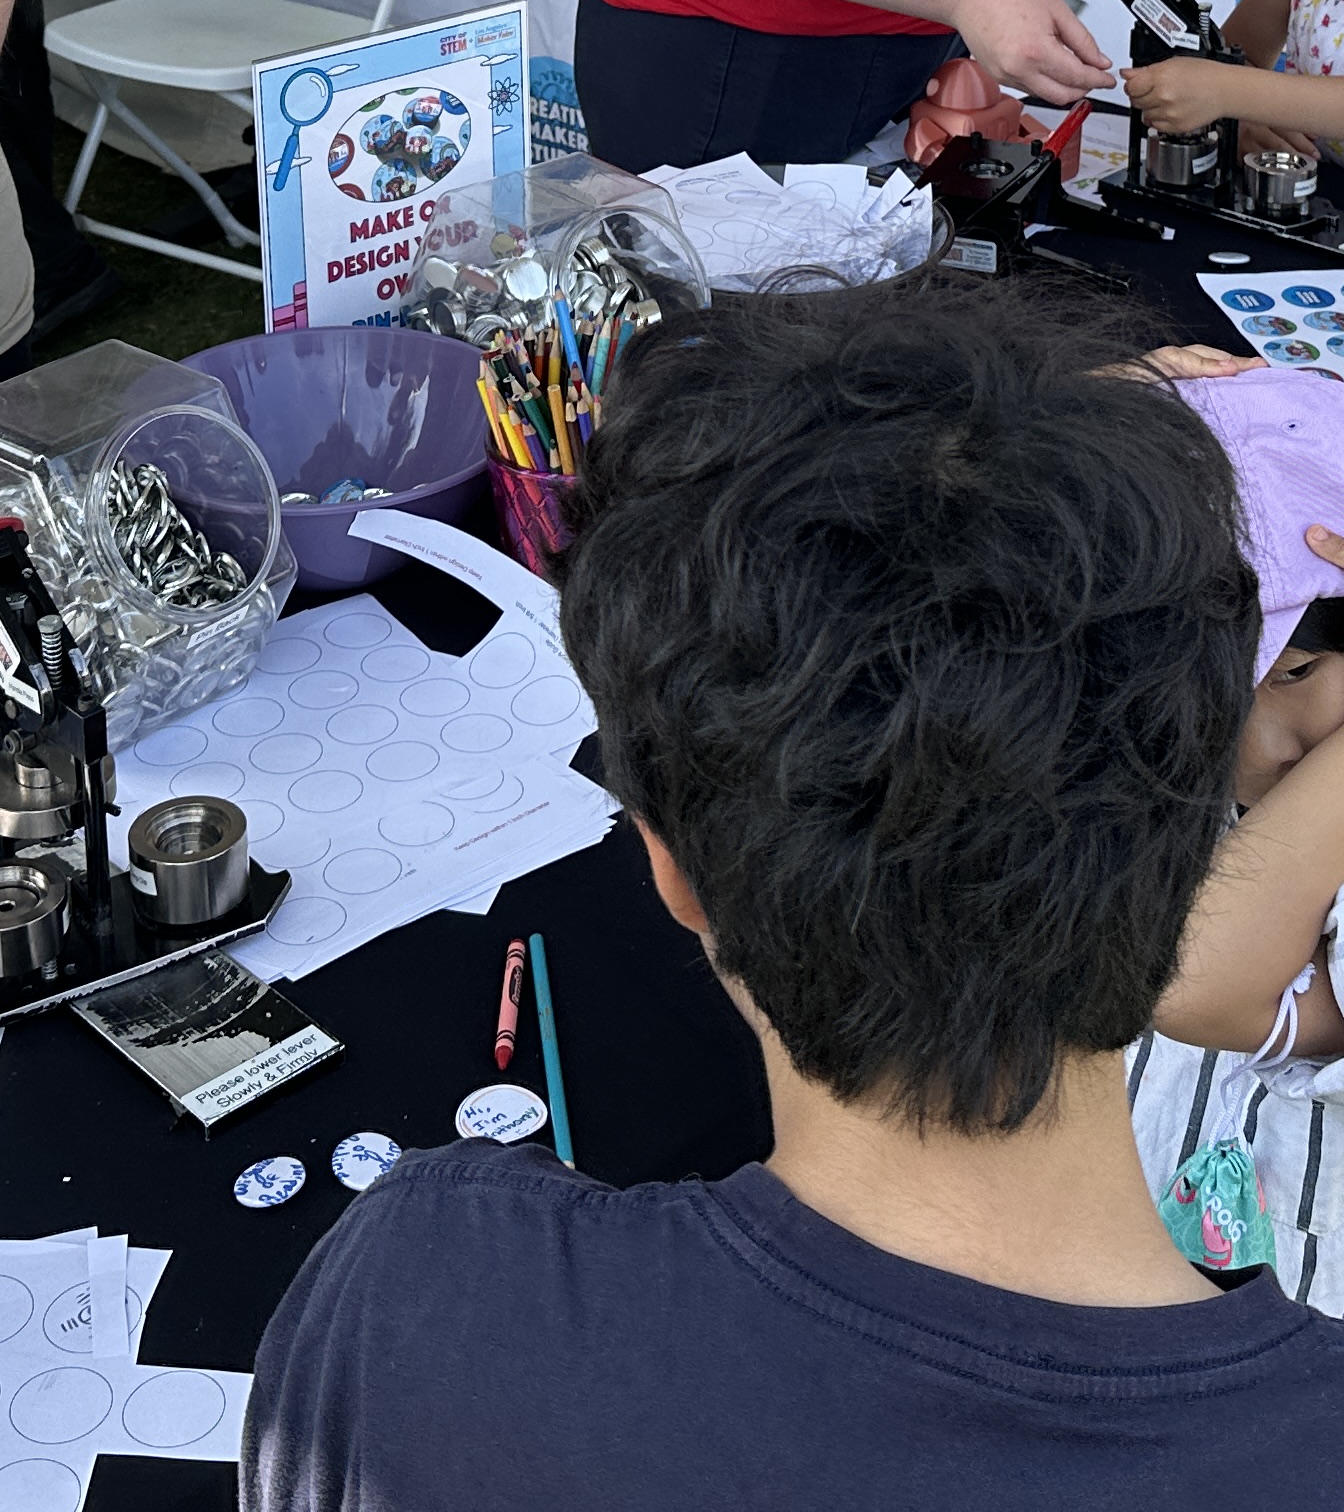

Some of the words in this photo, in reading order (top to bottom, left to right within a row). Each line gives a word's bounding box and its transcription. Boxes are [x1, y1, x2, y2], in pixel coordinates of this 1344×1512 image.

[440, 38, 467, 56] STEM
[350, 205, 414, 243] MAKE
[327, 240, 410, 283] DESIGN
[195, 1075, 245, 1104] Please
[244, 1053, 282, 1077] lower
[282, 1033, 317, 1056] lever
[217, 1080, 263, 1108] Slowly
[264, 1072, 278, 1082] &
[276, 1049, 318, 1076] Firmly
